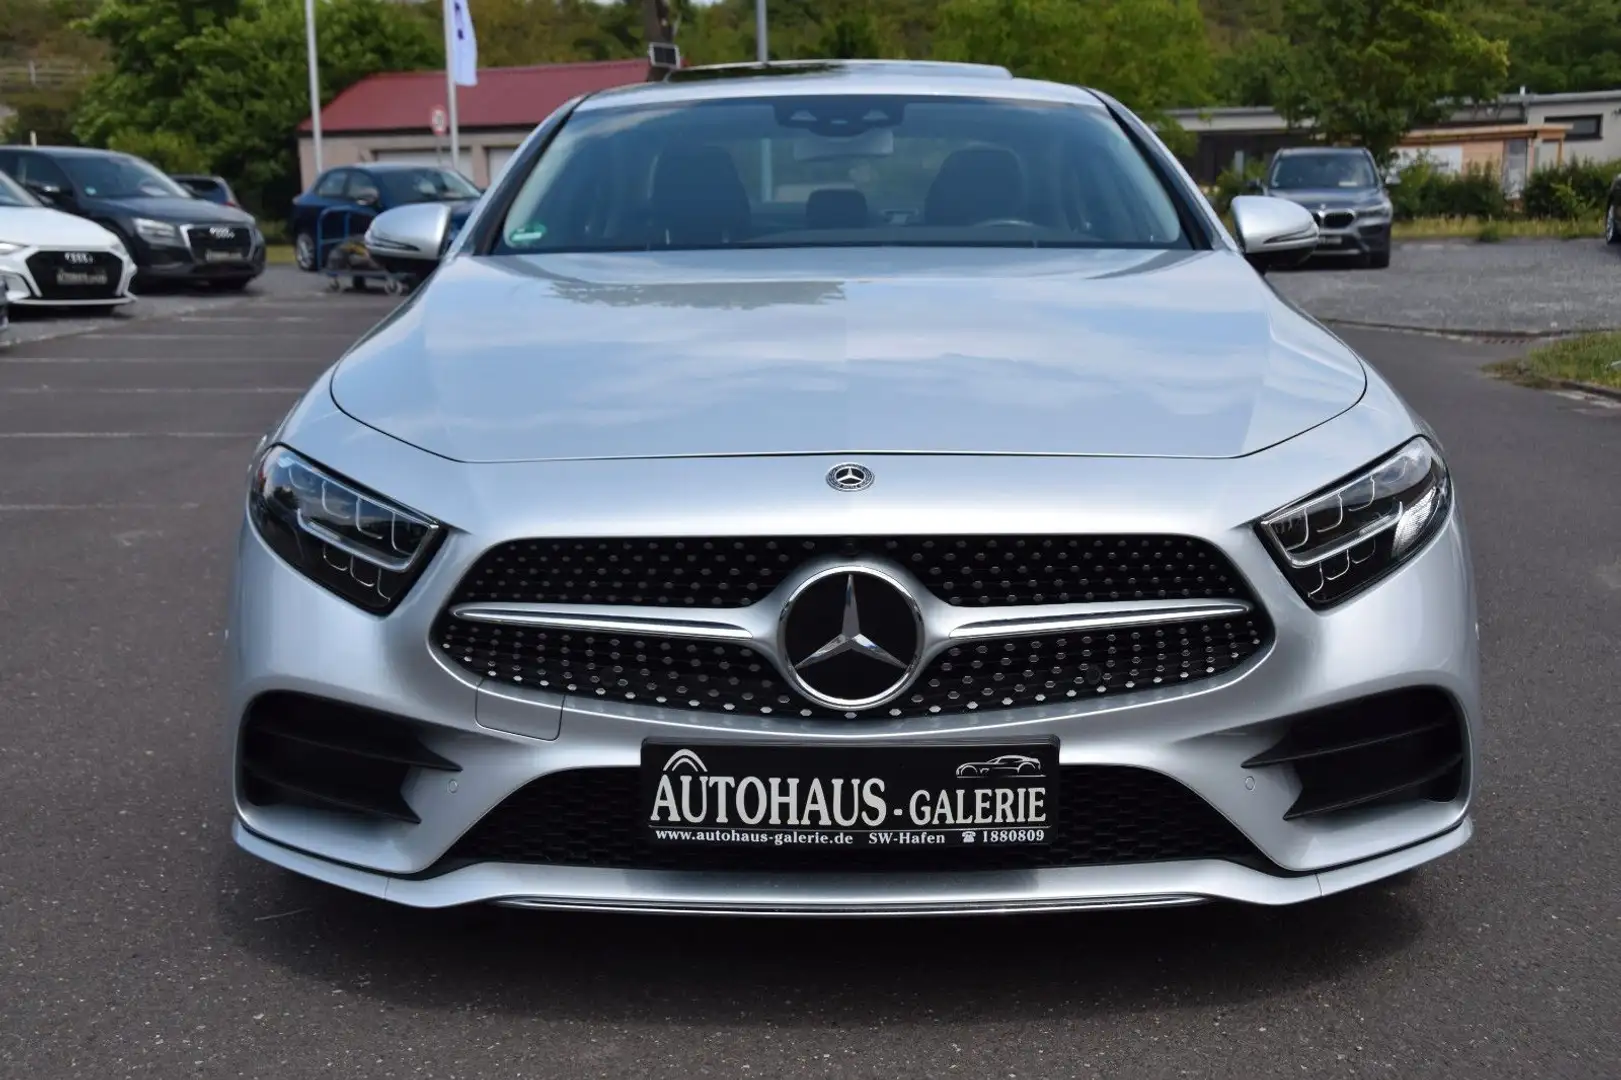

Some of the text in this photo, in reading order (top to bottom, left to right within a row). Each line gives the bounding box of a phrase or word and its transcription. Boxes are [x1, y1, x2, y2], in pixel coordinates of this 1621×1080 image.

[651, 774, 887, 827] AUTOHAUS
[909, 787, 1047, 826] GALERIE
[655, 829, 1045, 846] www.autohaus-galerie.de SW-Hafen 1880809
